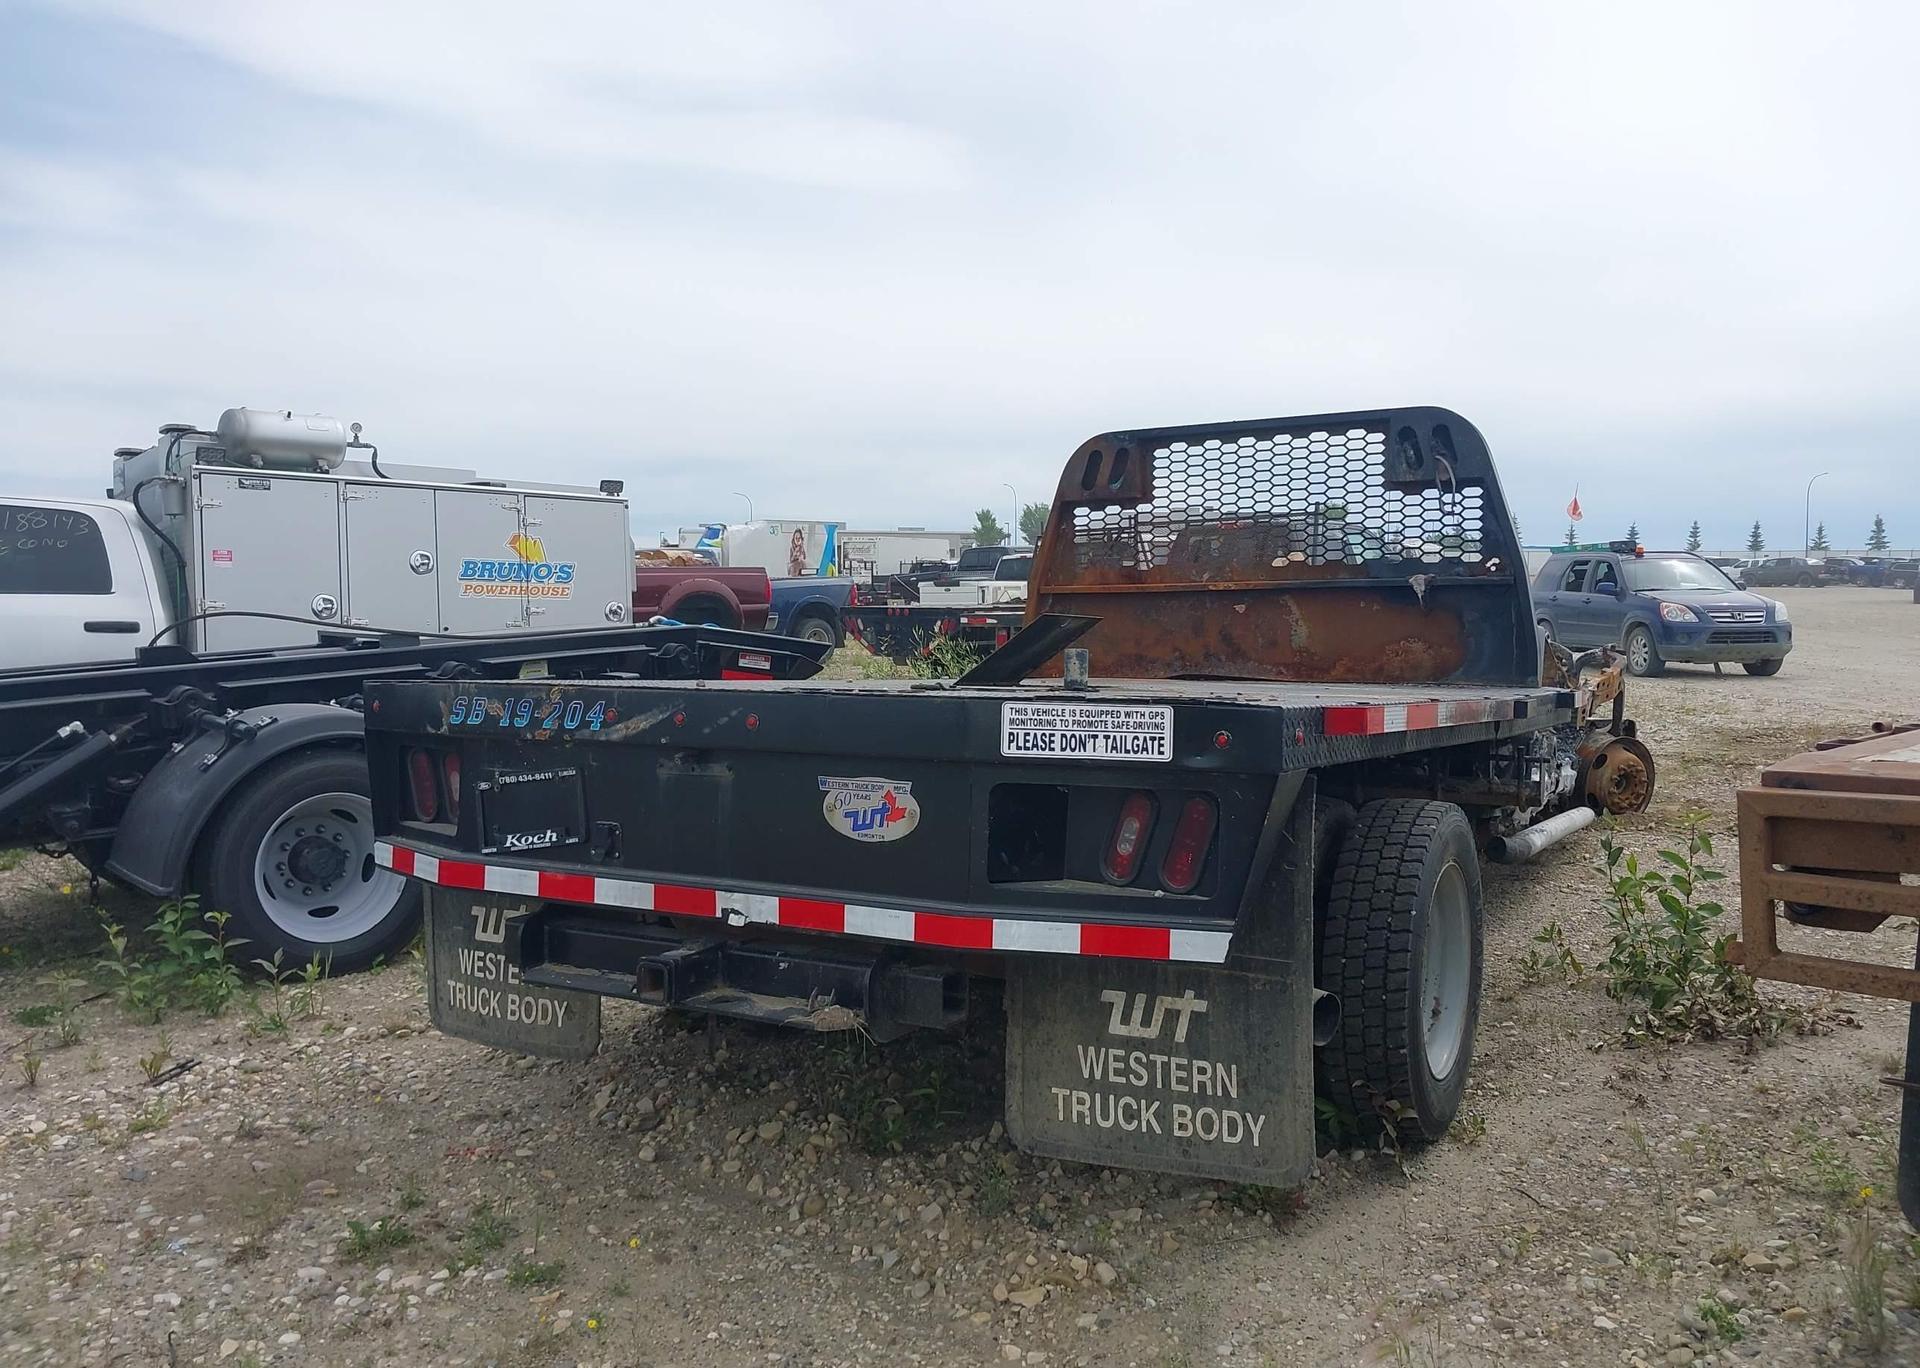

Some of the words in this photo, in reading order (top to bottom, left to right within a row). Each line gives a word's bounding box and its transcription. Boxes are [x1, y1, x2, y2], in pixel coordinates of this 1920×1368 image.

[459, 560, 575, 583] BRUNO'S
[463, 584, 570, 597] POWERHOUSE
[1009, 707, 1028, 717] THIS
[1031, 708, 1066, 718] VEHICLE
[1068, 709, 1077, 718] IS
[1079, 709, 1121, 719] EQUIPPED
[1124, 710, 1146, 720] WITH
[1148, 711, 1165, 721] GPS
[1009, 717, 1057, 729] MONITORING
[1059, 719, 1070, 729] TO
[1072, 719, 1109, 730] PROMOTE
[1111, 720, 1165, 731] SAFE-DRIVING
[1008, 731, 1056, 752] PLEASE
[1060, 733, 1099, 753] DON'T
[1103, 734, 1165, 756] TAILGATE
[518, 772, 552, 782] 434-8411
[819, 777, 850, 789] WESTERN
[851, 782, 869, 791] TRUCK
[870, 784, 885, 792] BODY
[834, 792, 852, 810] 60
[852, 793, 871, 801] YEARS
[504, 829, 558, 848] Koch
[458, 947, 525, 986] WESTE
[448, 980, 501, 1018] TRUCK
[507, 993, 568, 1028] BODY
[1077, 1044, 1238, 1098] WESTERN
[1051, 1087, 1162, 1134] TRUCK
[1173, 1103, 1265, 1147] BODY
